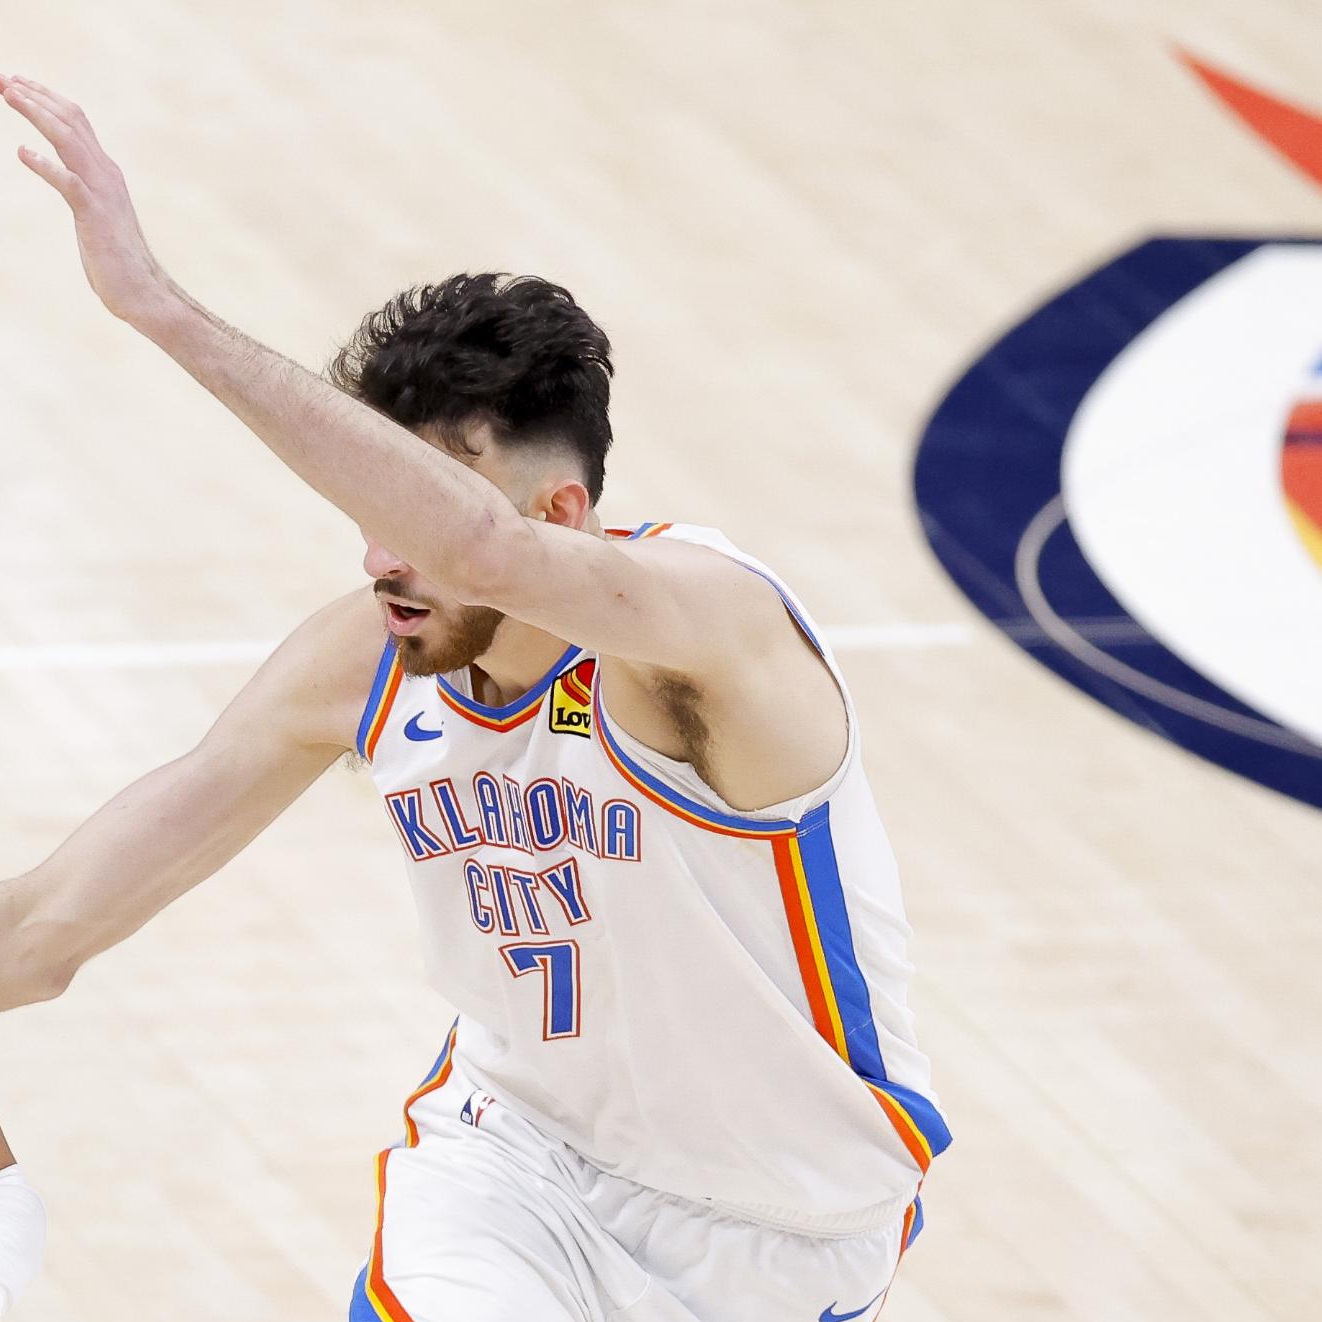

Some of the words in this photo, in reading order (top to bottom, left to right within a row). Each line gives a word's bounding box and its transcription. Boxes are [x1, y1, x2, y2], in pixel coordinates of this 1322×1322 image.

[555, 707, 591, 729] LOV
[385, 771, 641, 861] KLAHOMA
[464, 857, 592, 936] CITY
[499, 940, 581, 1041] 7
